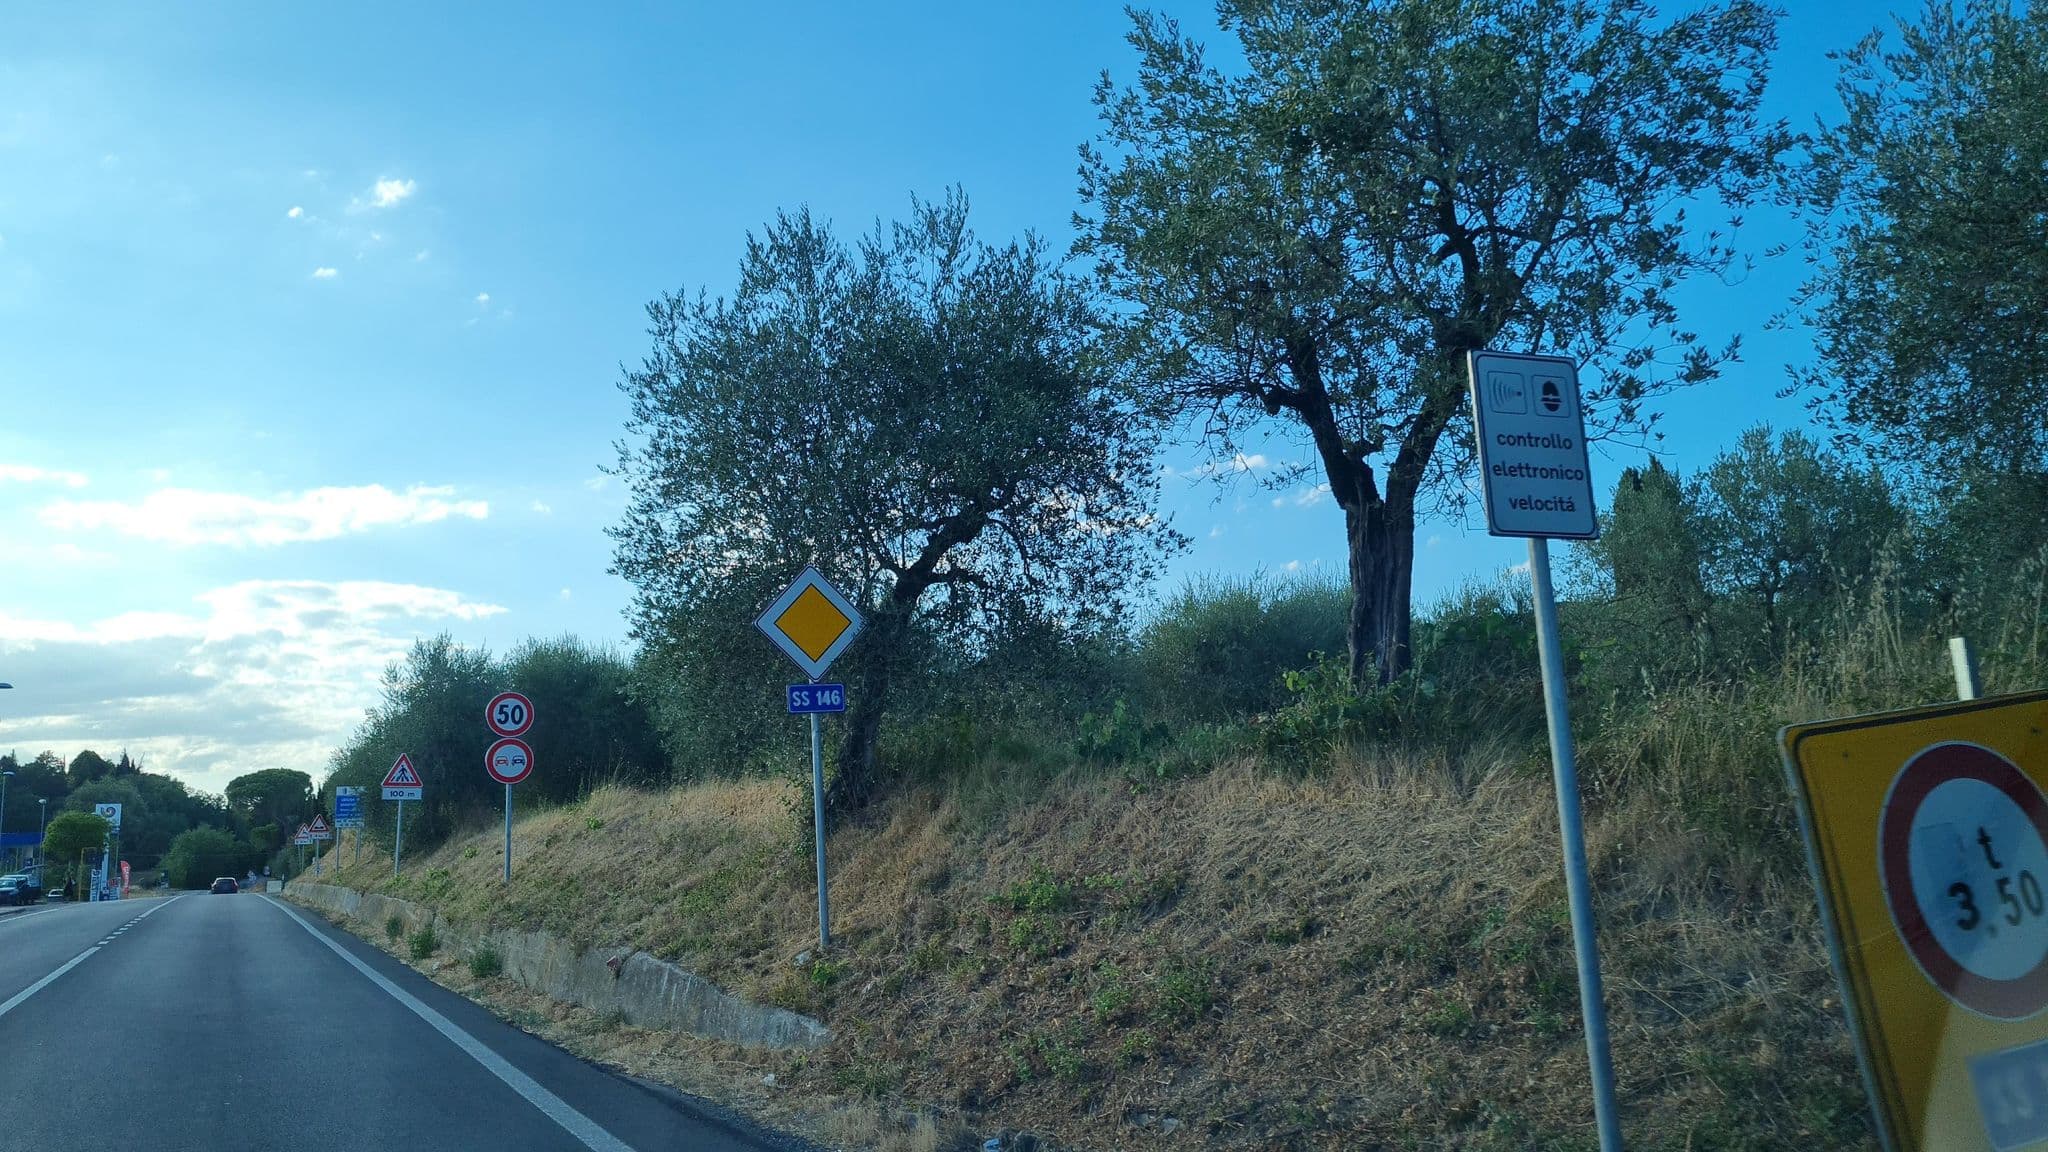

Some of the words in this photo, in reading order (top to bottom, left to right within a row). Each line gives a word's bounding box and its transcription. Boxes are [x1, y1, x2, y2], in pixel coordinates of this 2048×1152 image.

[1496, 433, 1574, 450] controllo
[1492, 461, 1584, 481] elettronico
[792, 691, 810, 707] SS
[816, 690, 841, 706] 146
[496, 704, 525, 726] 50
[389, 789, 405, 798] 100
[1976, 825, 2003, 871] t
